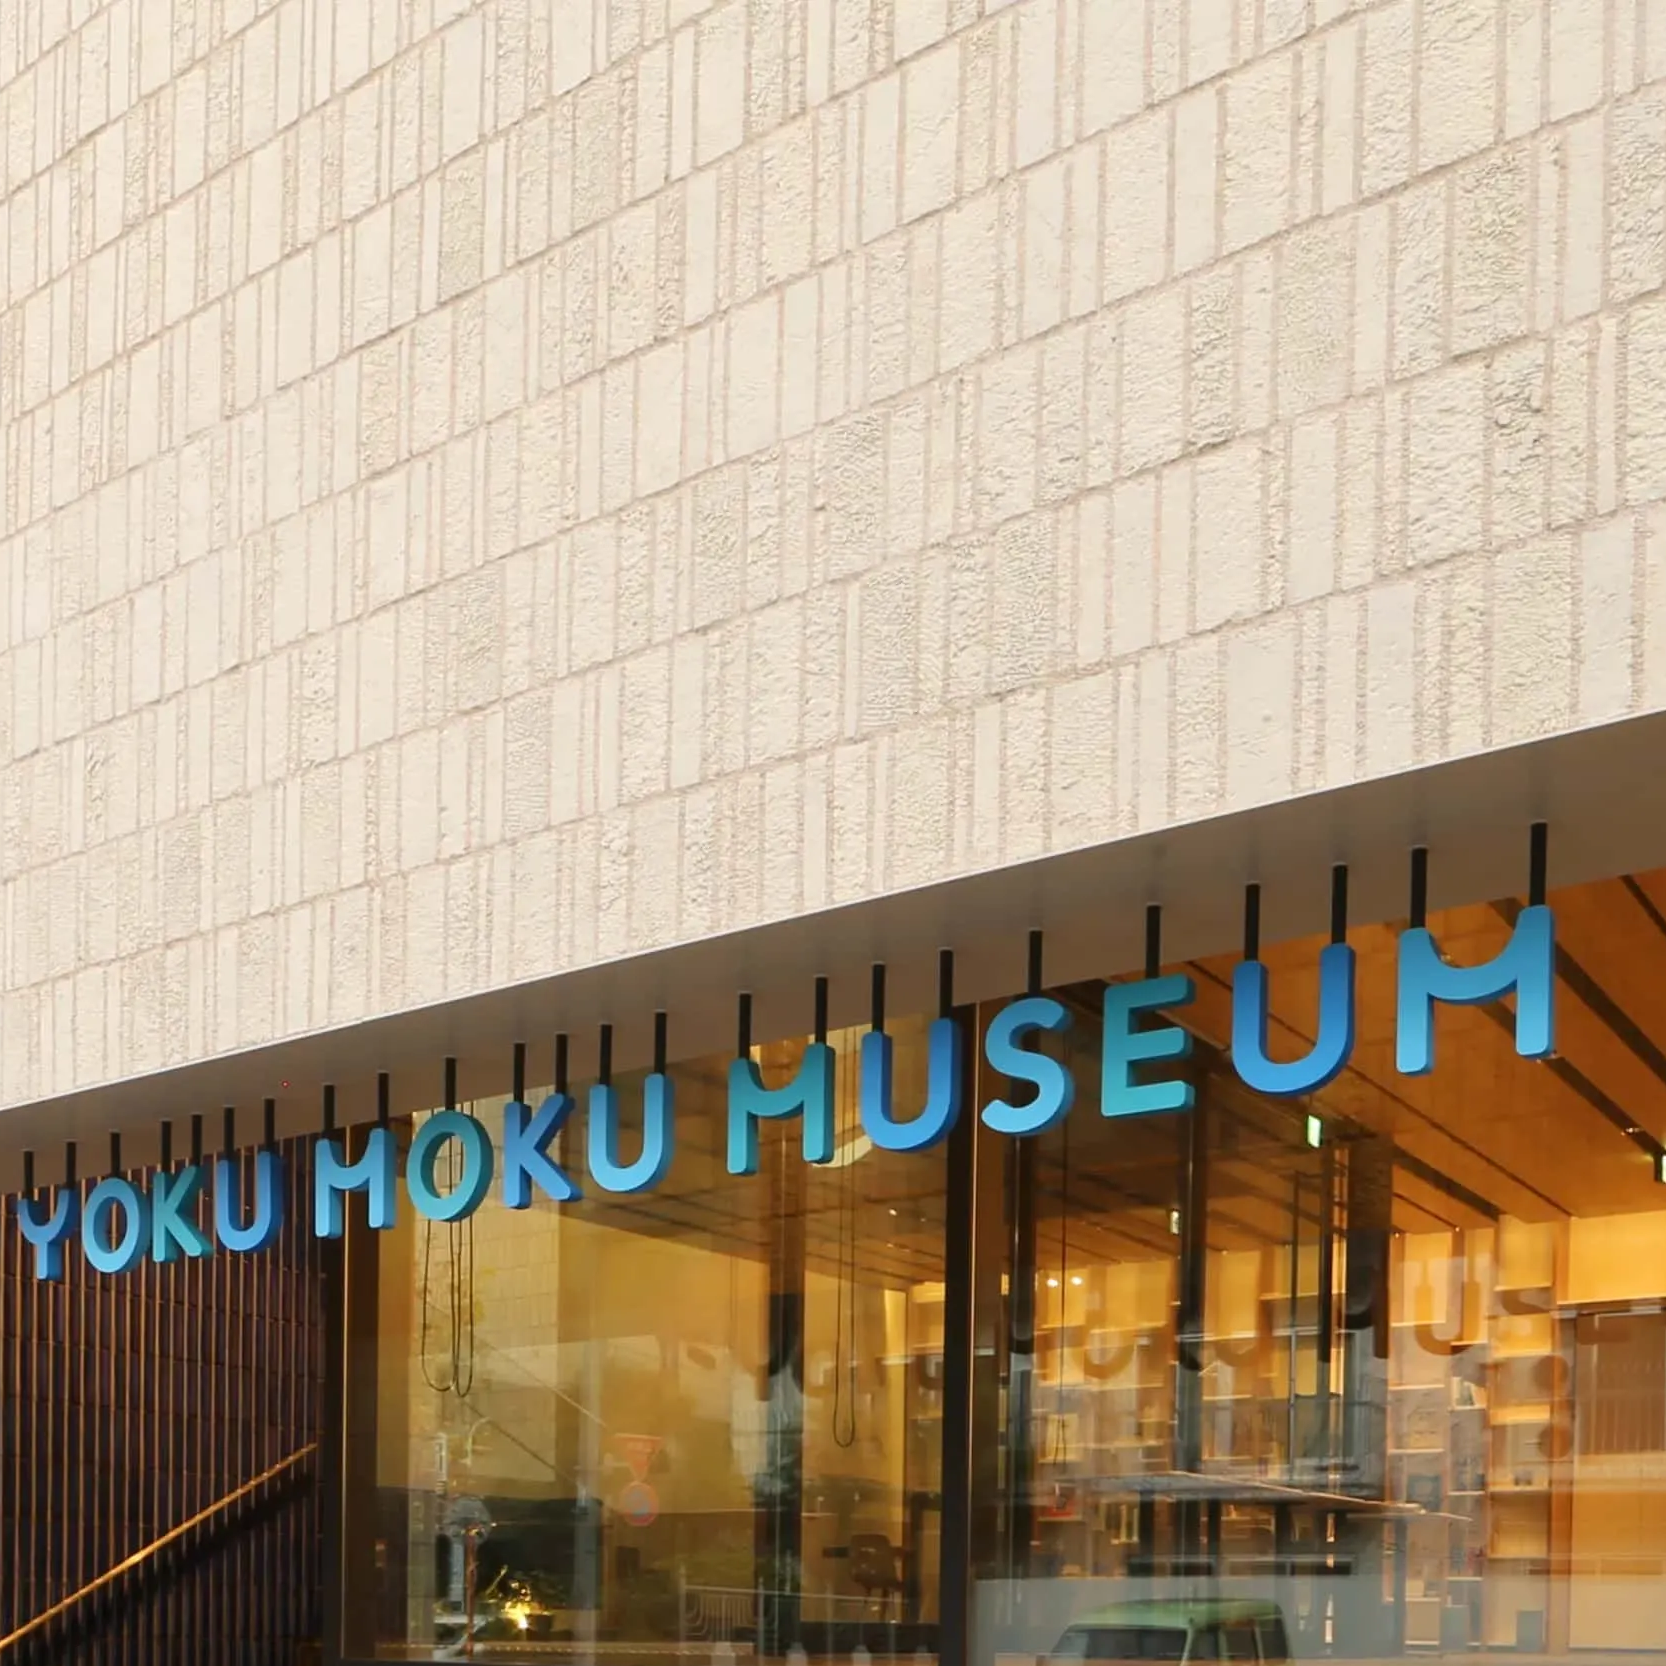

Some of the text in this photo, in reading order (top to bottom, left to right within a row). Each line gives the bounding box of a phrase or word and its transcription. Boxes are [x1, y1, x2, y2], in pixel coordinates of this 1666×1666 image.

[18, 904, 1556, 1281] YOKU MOKU MUSEUM
